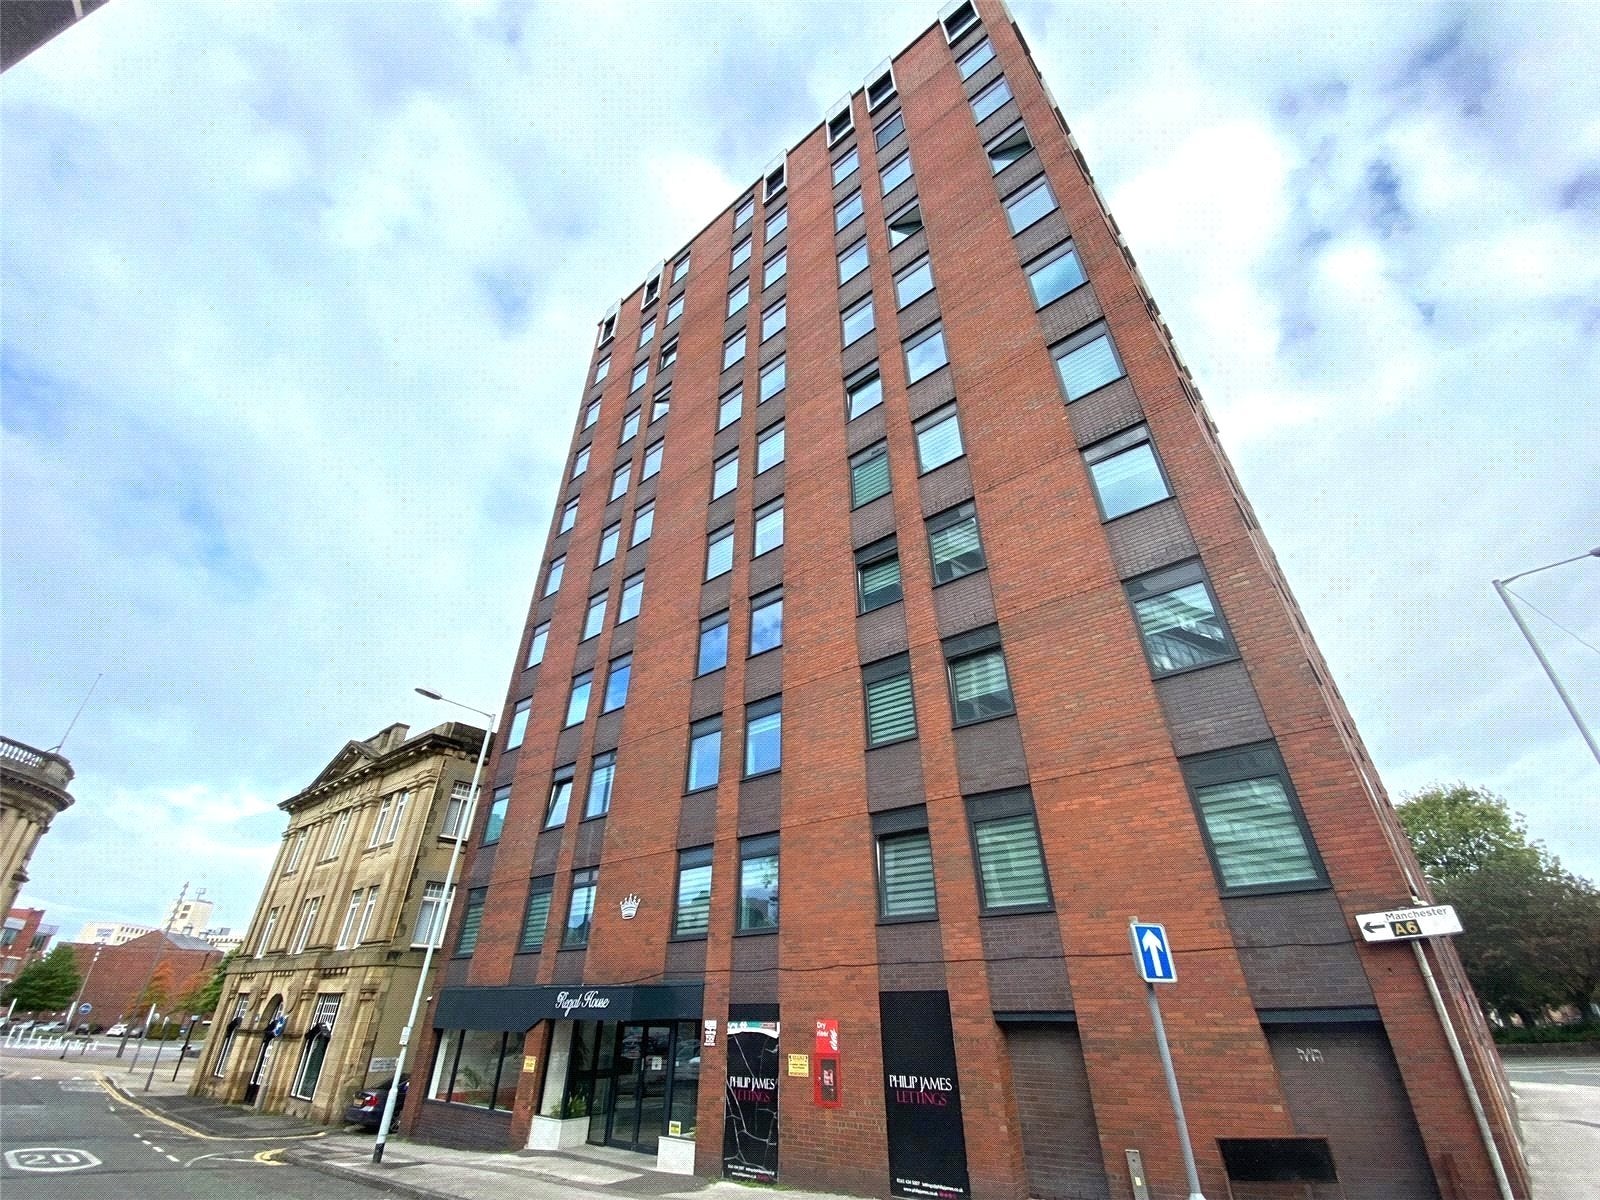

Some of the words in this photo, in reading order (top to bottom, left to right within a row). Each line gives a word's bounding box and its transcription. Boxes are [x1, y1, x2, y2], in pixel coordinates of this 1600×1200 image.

[1385, 907, 1447, 921] Manchester
[1395, 921, 1418, 935] A6
[555, 991, 583, 1017] Regal
[581, 990, 610, 1008] House
[816, 1021, 827, 1030] Dry
[729, 1076, 752, 1089] PHILIP
[751, 1077, 776, 1092] JAMES
[889, 1074, 918, 1089] PHILIP
[919, 1076, 953, 1093] JAMES
[896, 1090, 948, 1106] LETTINGS
[20, 1153, 80, 1165] 20
